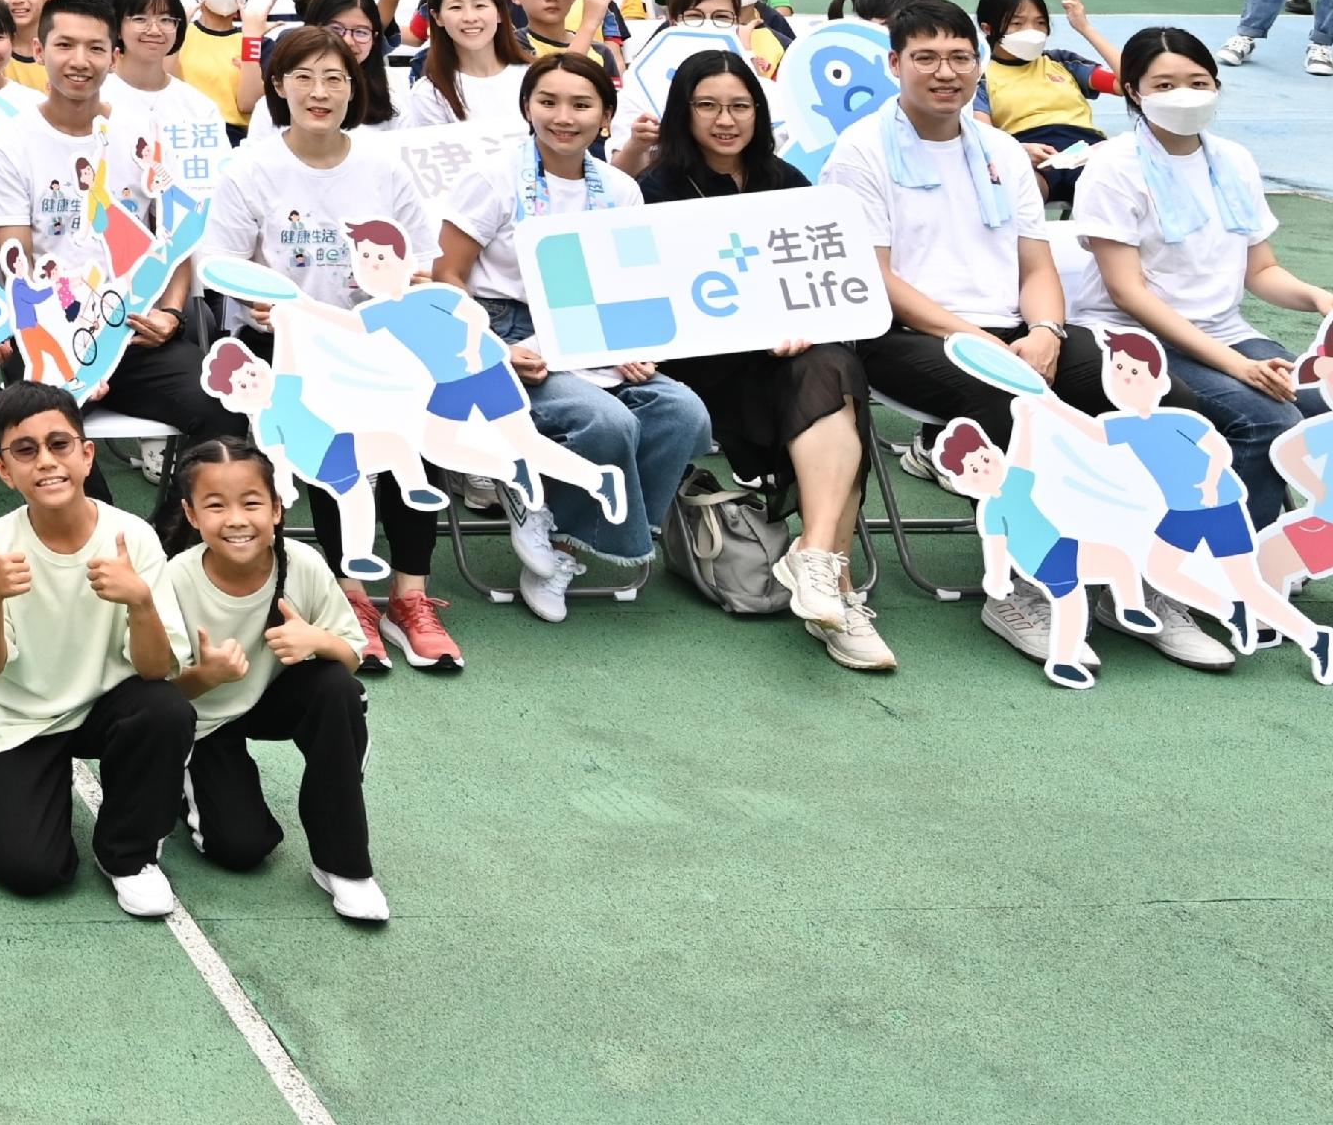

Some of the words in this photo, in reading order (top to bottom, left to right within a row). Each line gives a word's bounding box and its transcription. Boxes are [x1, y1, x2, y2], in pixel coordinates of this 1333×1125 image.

[281, 229, 337, 244] 健康生活
[767, 222, 847, 265] 生活
[779, 270, 870, 311] Life
